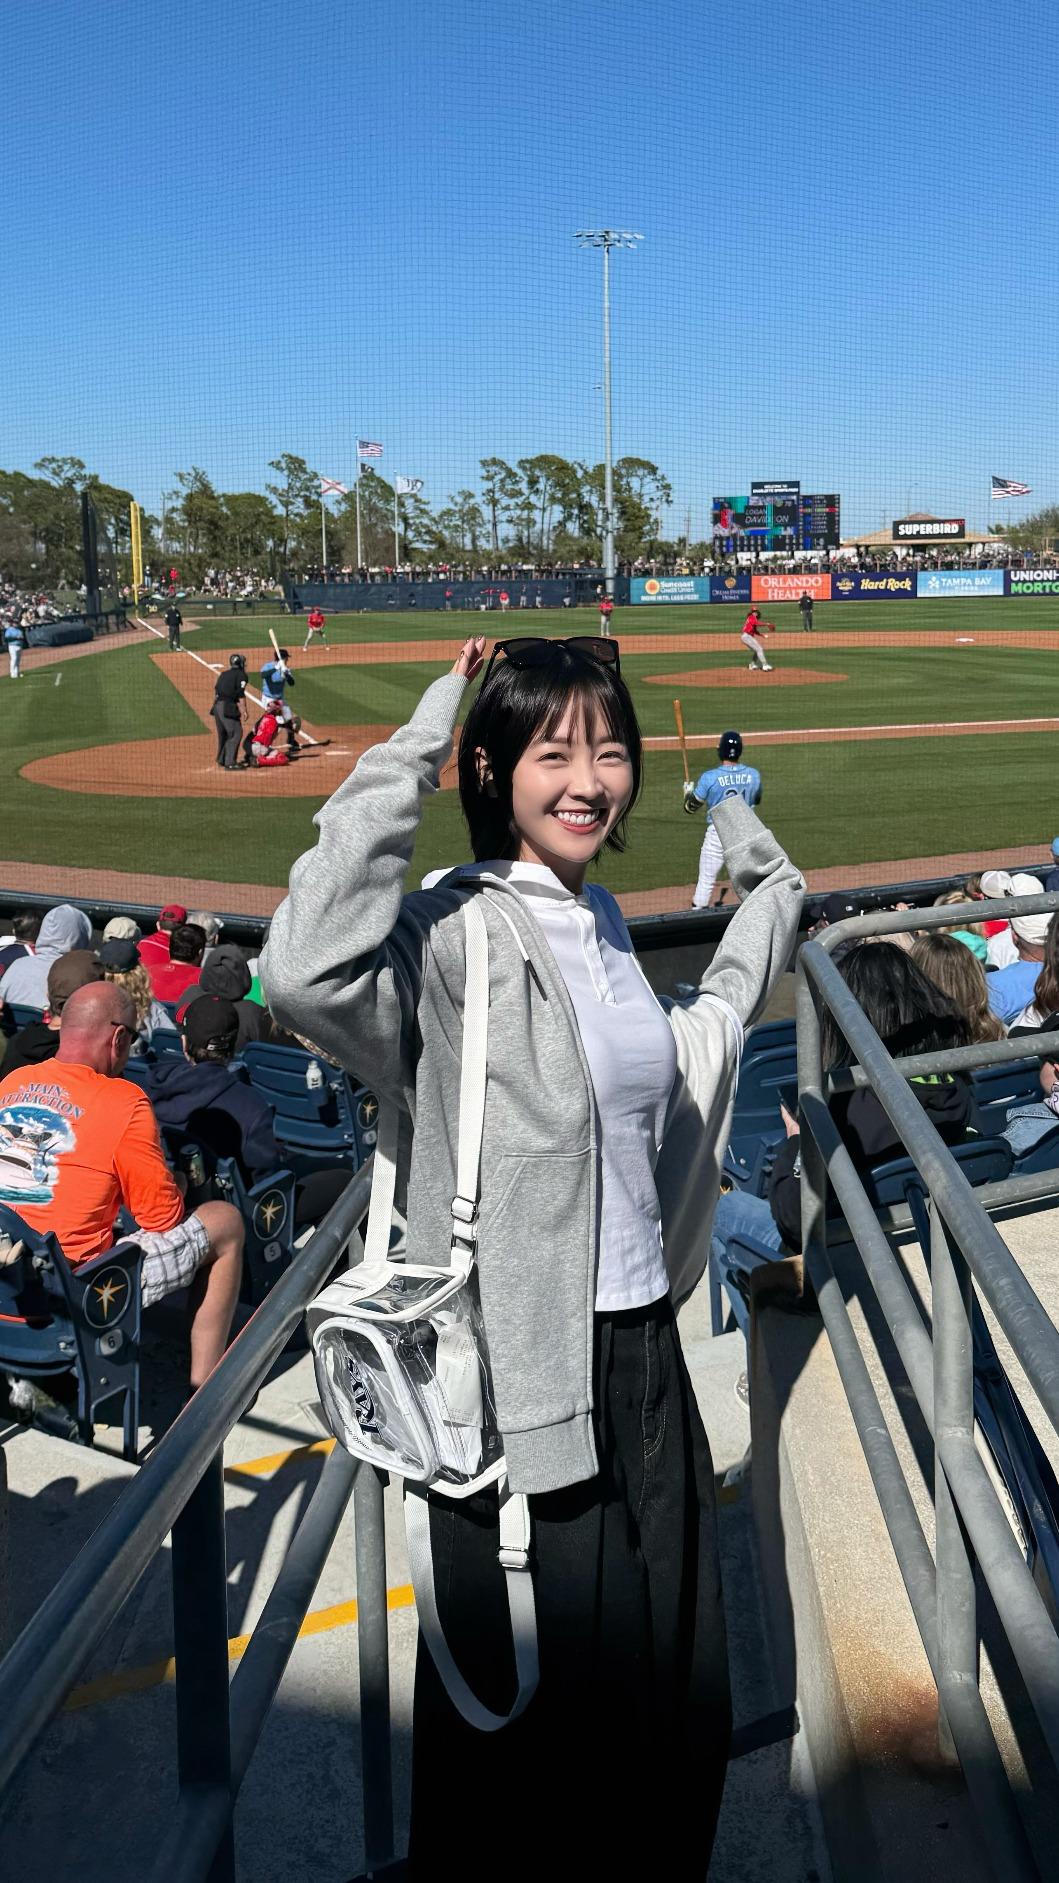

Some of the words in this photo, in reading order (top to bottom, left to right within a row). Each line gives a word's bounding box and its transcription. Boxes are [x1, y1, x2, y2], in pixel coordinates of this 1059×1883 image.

[898, 523, 959, 536] SUPERBIRD
[760, 576, 822, 588] ORLANDO
[860, 579, 886, 591] Hard
[887, 577, 912, 592] Rock
[942, 578, 972, 587] TAMPA
[974, 576, 993, 586] BAY
[718, 774, 753, 787] DELUCA
[28, 1083, 63, 1097] MAIN
[269, 1245, 276, 1257] 5
[107, 1336, 115, 1348] 6
